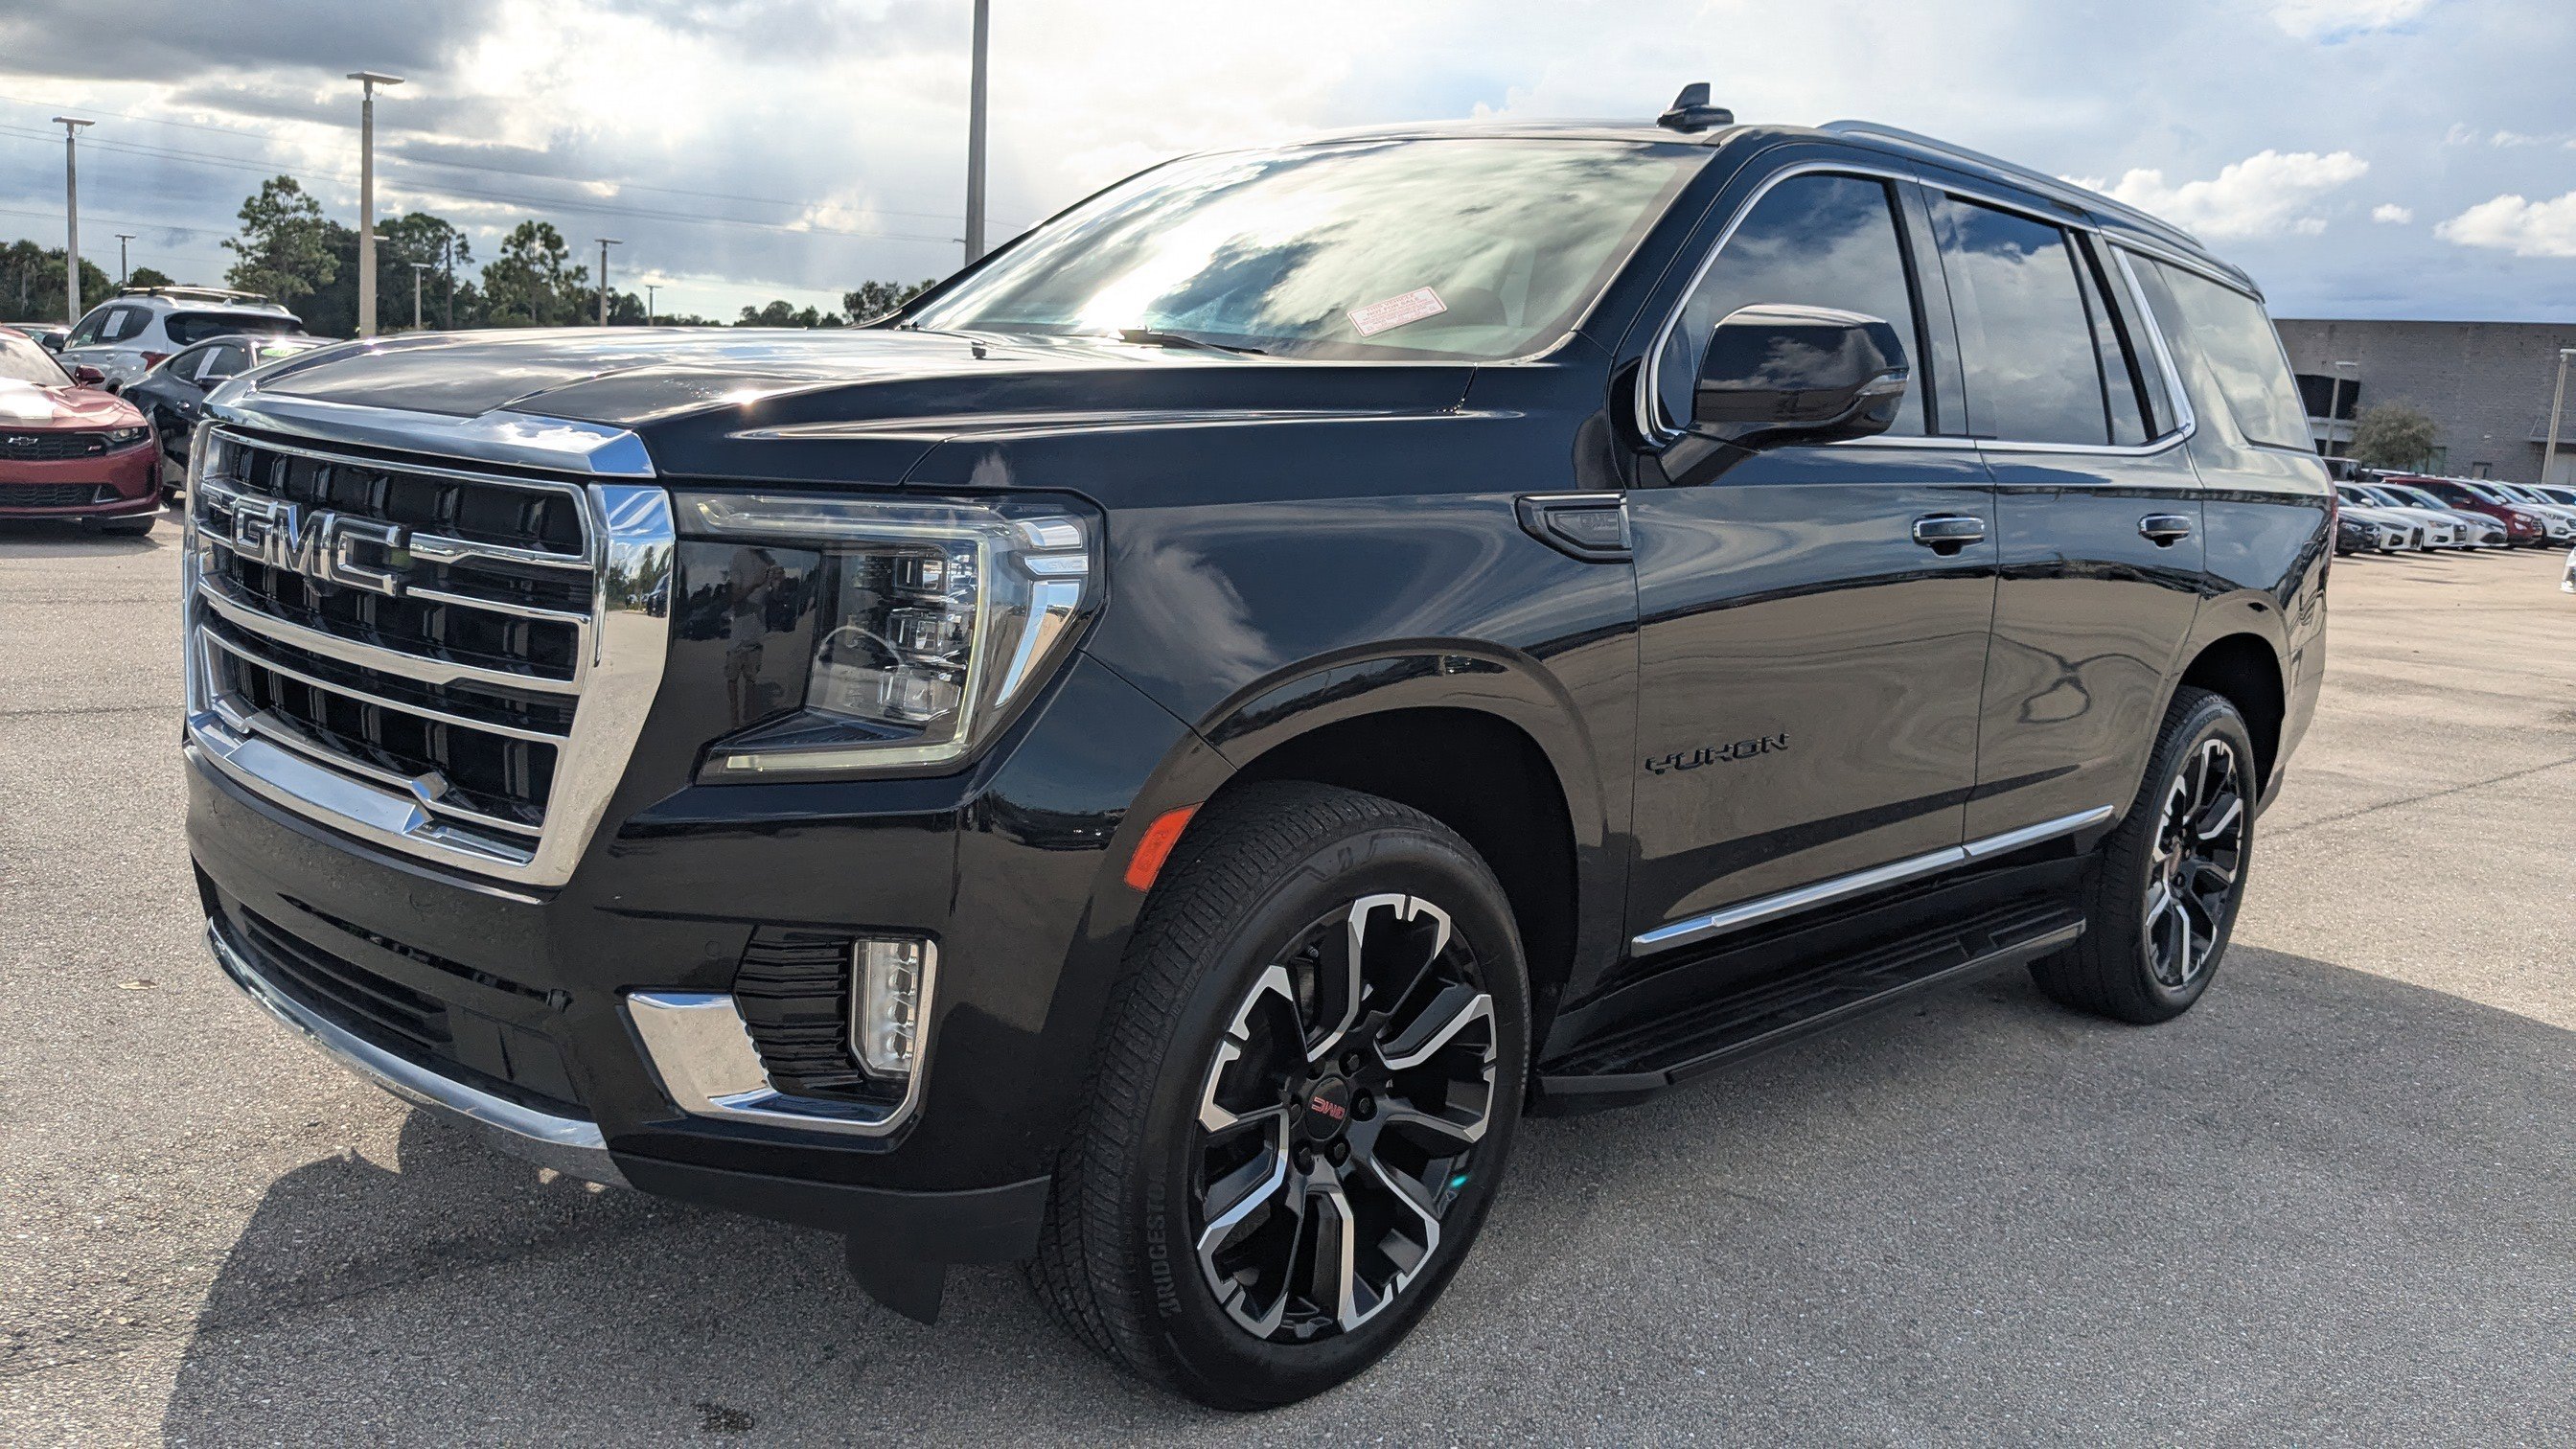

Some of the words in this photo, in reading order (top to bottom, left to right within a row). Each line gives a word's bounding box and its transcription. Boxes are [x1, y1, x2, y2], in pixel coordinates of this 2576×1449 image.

[231, 496, 401, 597] GMC
[1645, 732, 1790, 775] YUKON
[1311, 1096, 1346, 1120] GMC
[1146, 1158, 1182, 1318] BRIDGESTO
